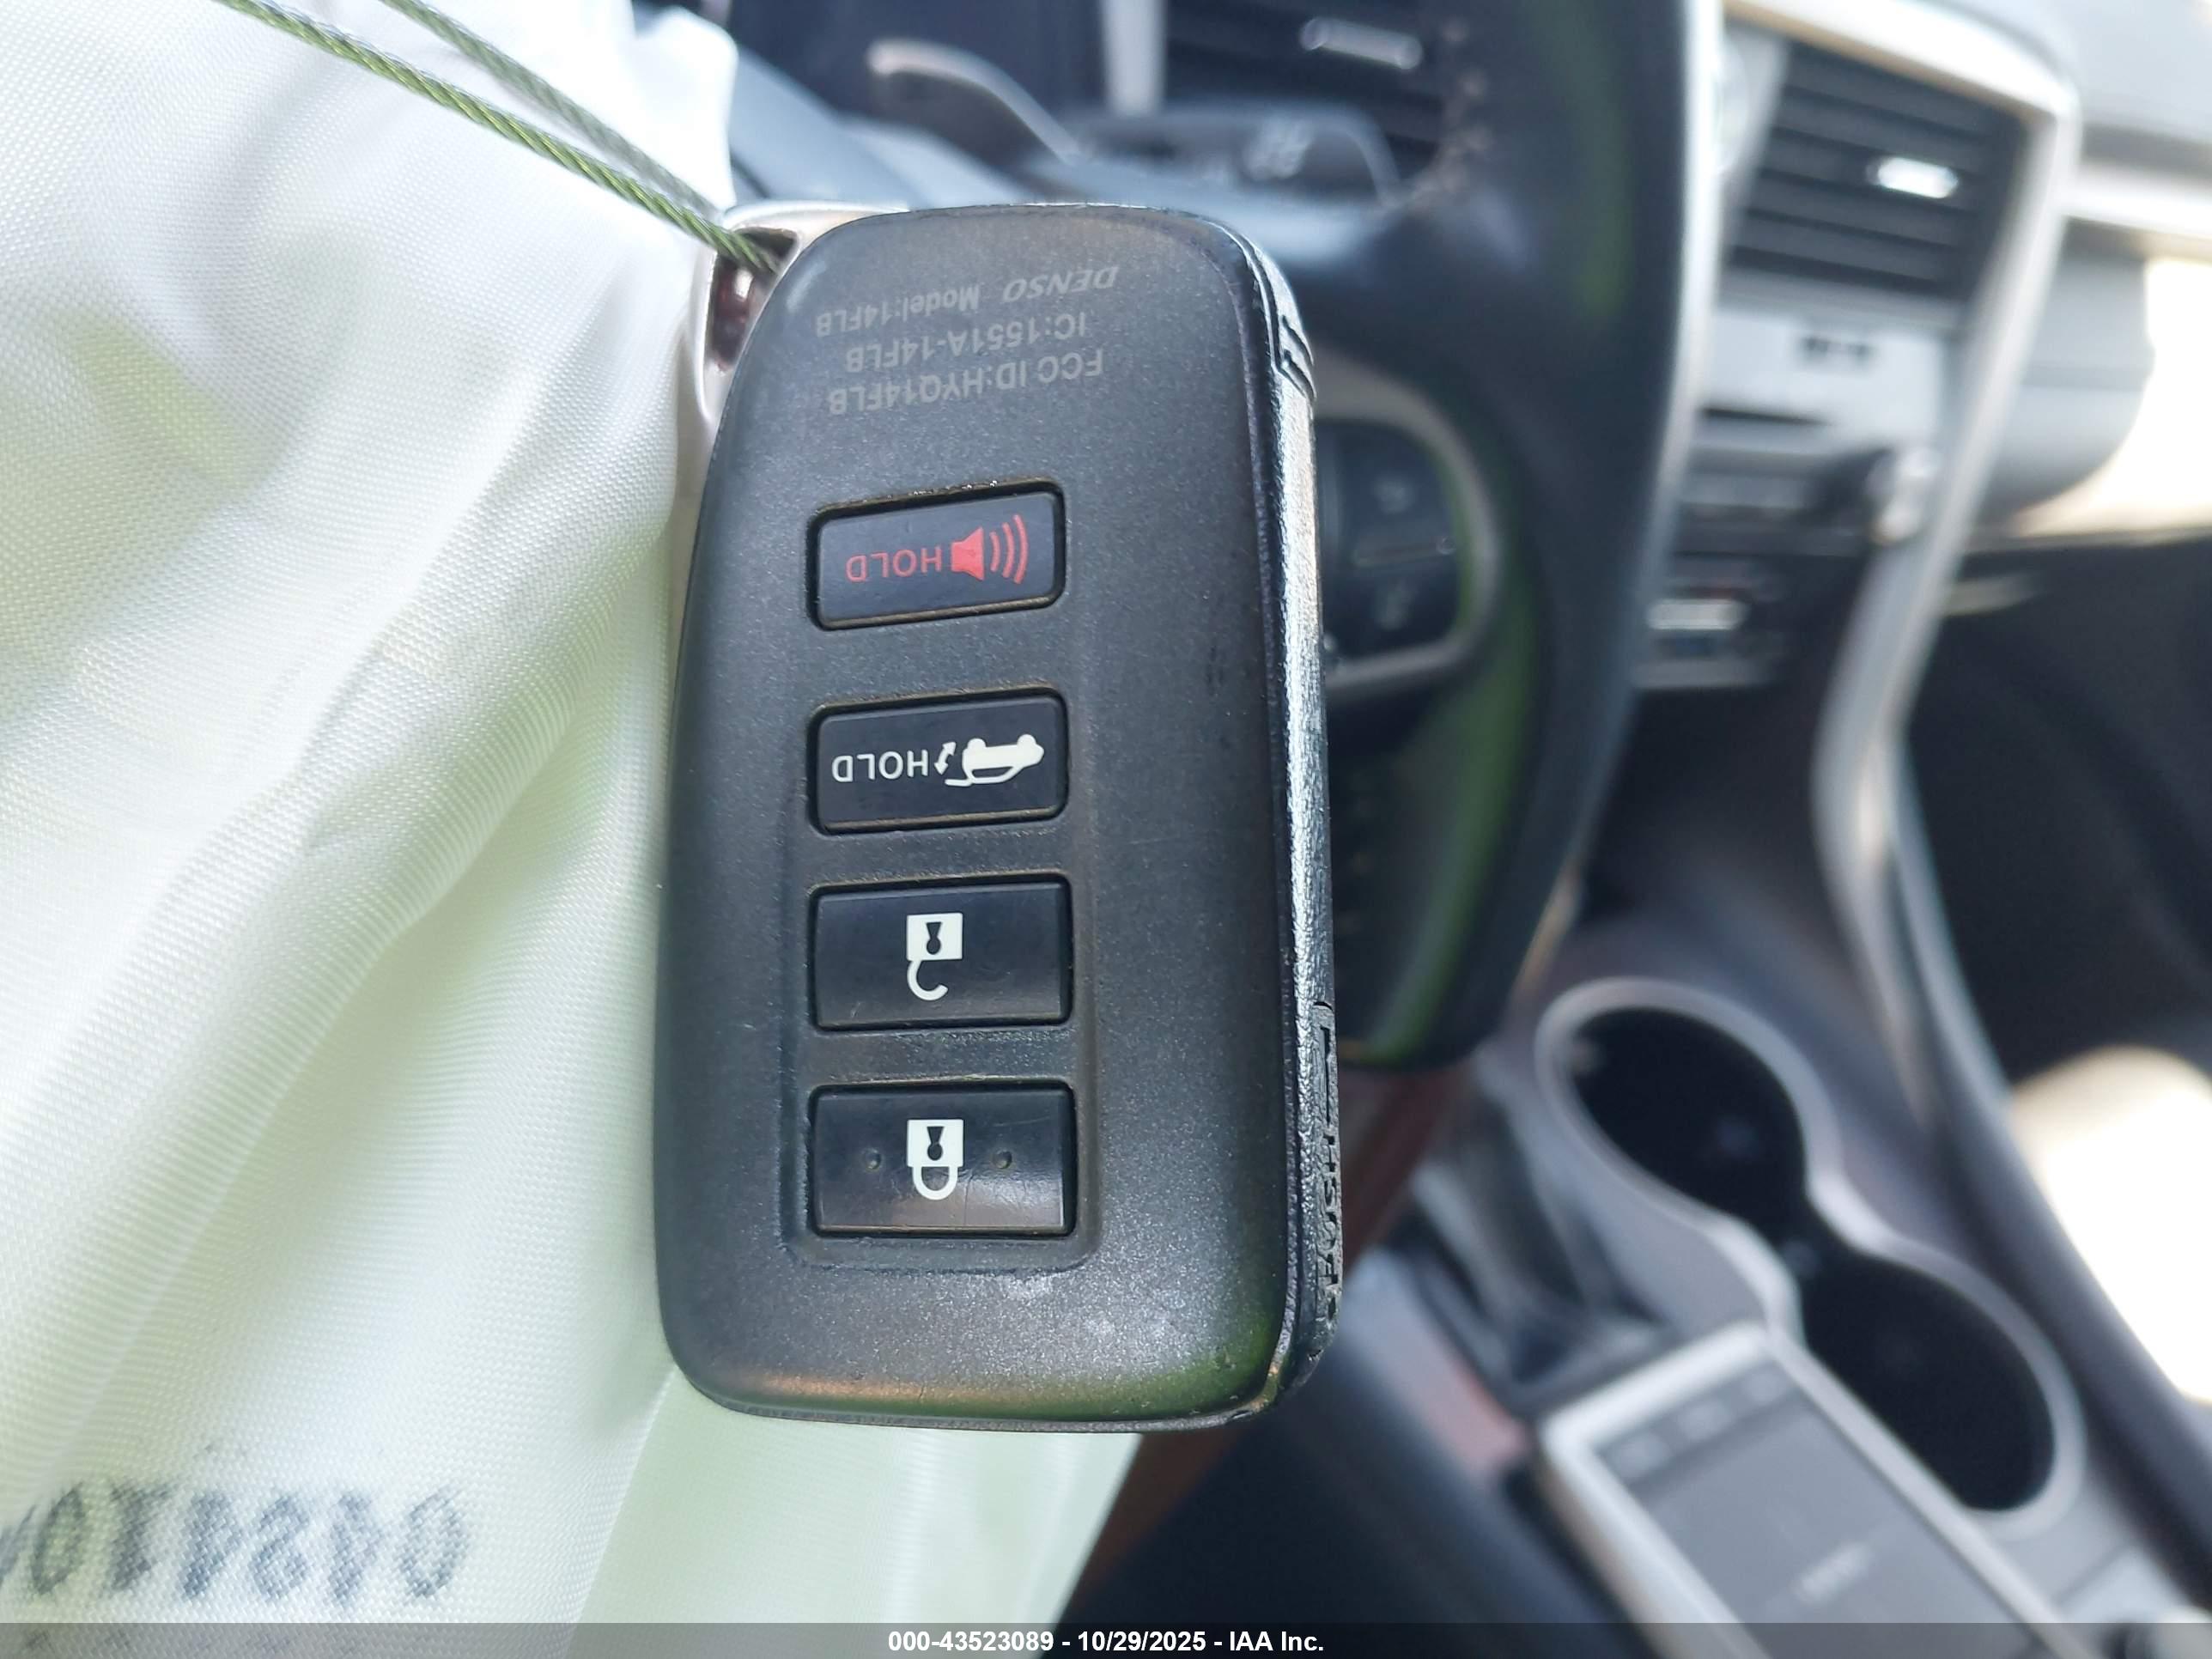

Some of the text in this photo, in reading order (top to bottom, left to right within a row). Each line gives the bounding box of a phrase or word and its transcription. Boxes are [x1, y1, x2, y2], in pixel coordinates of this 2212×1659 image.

[815, 266, 1119, 337] DENSO Model:14FLB
[845, 312, 1087, 373] IC:1551A-14FLB
[827, 348, 1104, 415] FCC ID:HYQ14FLB
[845, 545, 943, 582] HOLD
[831, 749, 929, 783] HOLD
